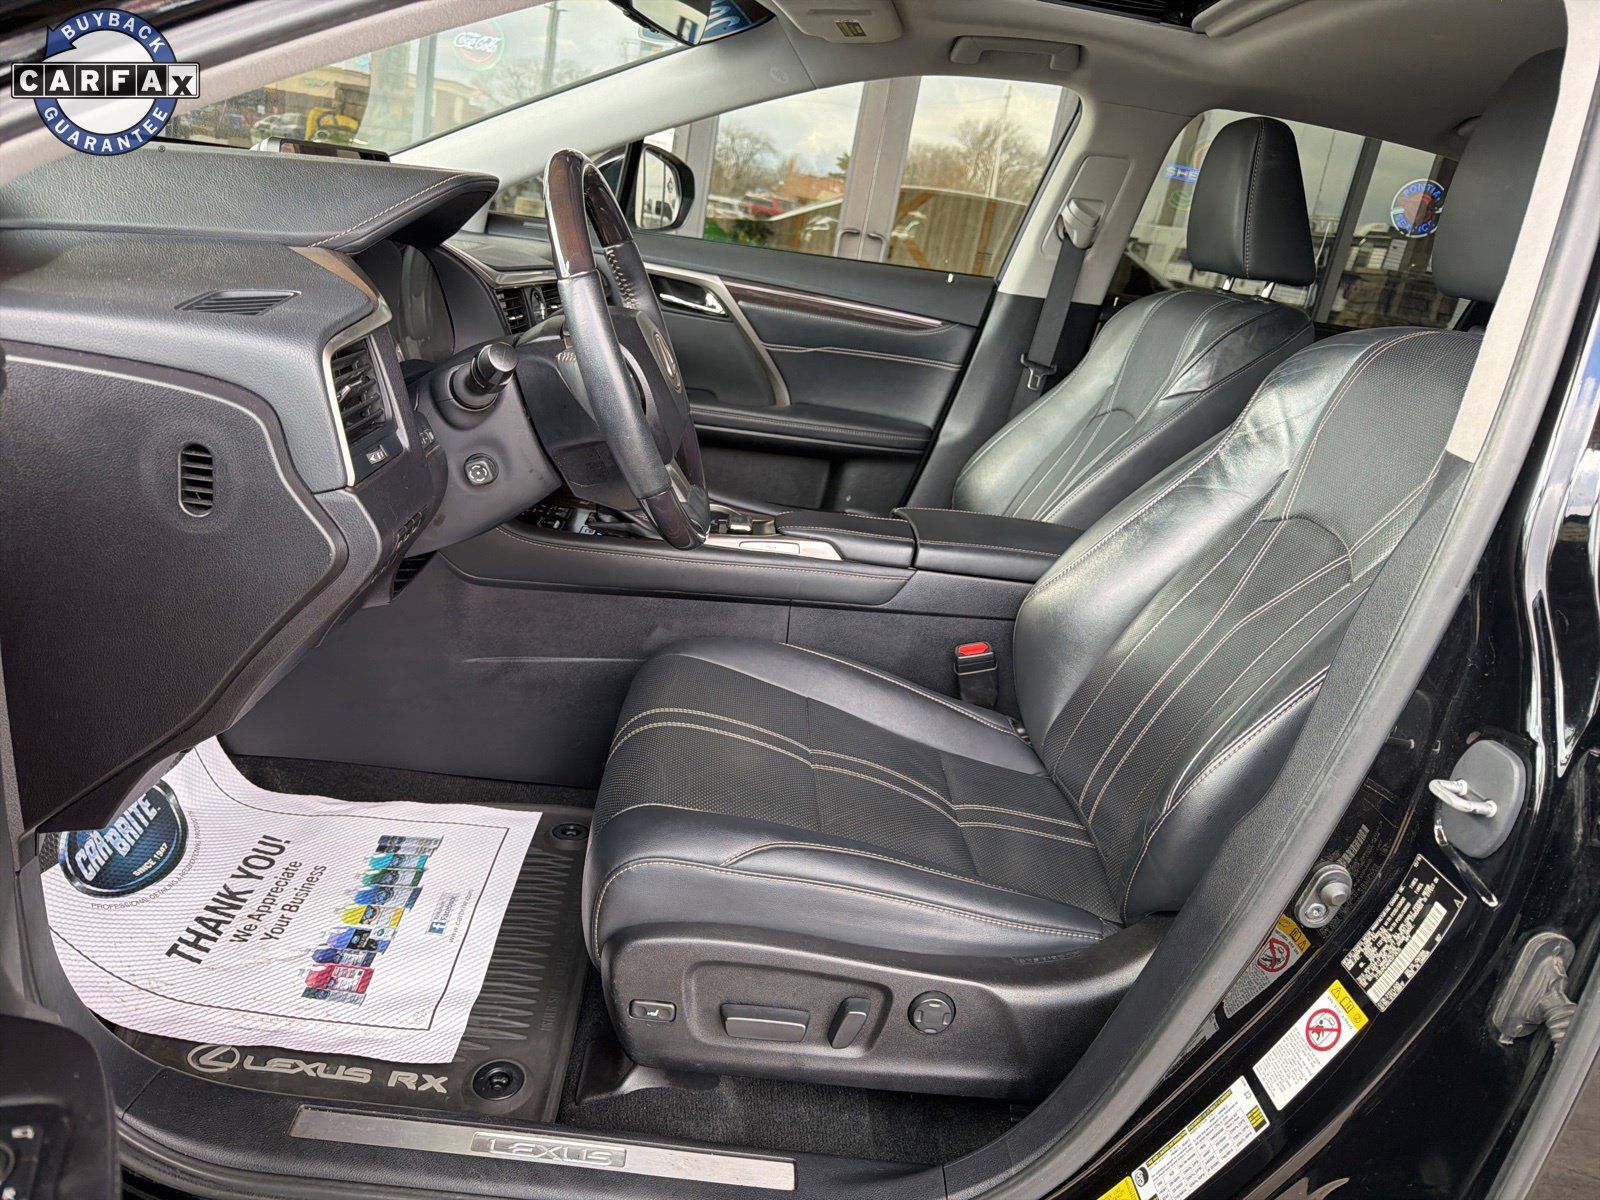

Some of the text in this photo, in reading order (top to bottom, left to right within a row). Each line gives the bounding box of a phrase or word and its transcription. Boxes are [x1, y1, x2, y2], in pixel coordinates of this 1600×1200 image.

[1166, 167, 1199, 180] SHE
[1403, 183, 1441, 201] PONTIA
[75, 793, 158, 882] CAR BRITE
[132, 842, 169, 877] SINCE 1947
[165, 834, 291, 965] THANK YOU!
[229, 860, 303, 943] We Appreciate
[259, 865, 327, 941] Your Business
[243, 1055, 449, 1094] LEXUS RX
[489, 1138, 613, 1166] LEXUS
